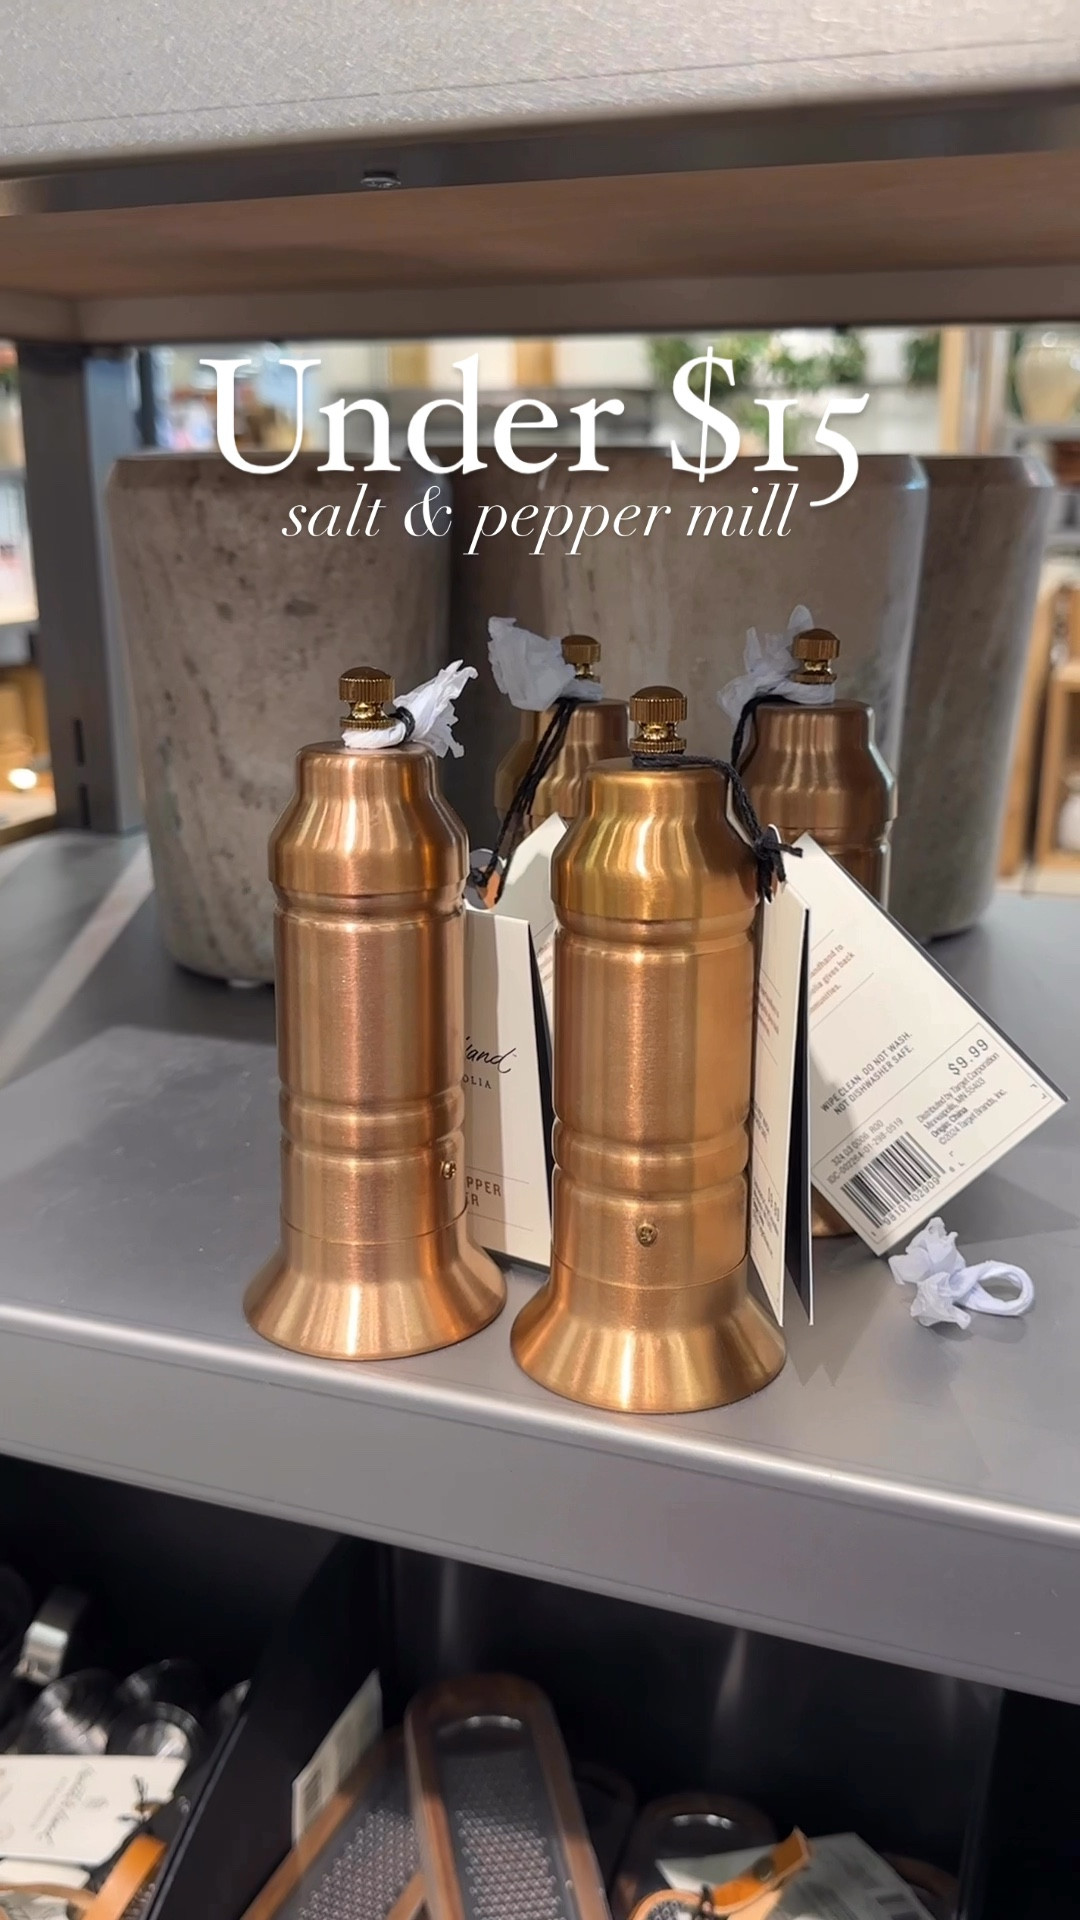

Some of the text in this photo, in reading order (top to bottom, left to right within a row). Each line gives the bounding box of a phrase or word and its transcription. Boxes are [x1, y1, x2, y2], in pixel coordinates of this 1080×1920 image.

[820, 1094, 839, 1112] WIPE
[862, 1063, 874, 1075] DO
[873, 1050, 889, 1065] NOT
[887, 1030, 911, 1053] WASH.
[947, 1037, 988, 1076] $9.99
[834, 1043, 913, 1114] NOT DISHWASHER SAFE.
[916, 1095, 946, 1123] Distributed
[950, 1076, 969, 1094] Target
[966, 1050, 999, 1081] Corporation
[955, 1092, 967, 1103] MN
[965, 1076, 985, 1095] 55403
[948, 1105, 967, 1123] China
[958, 1112, 977, 1130] Target
[466, 1175, 502, 1197] PPER
